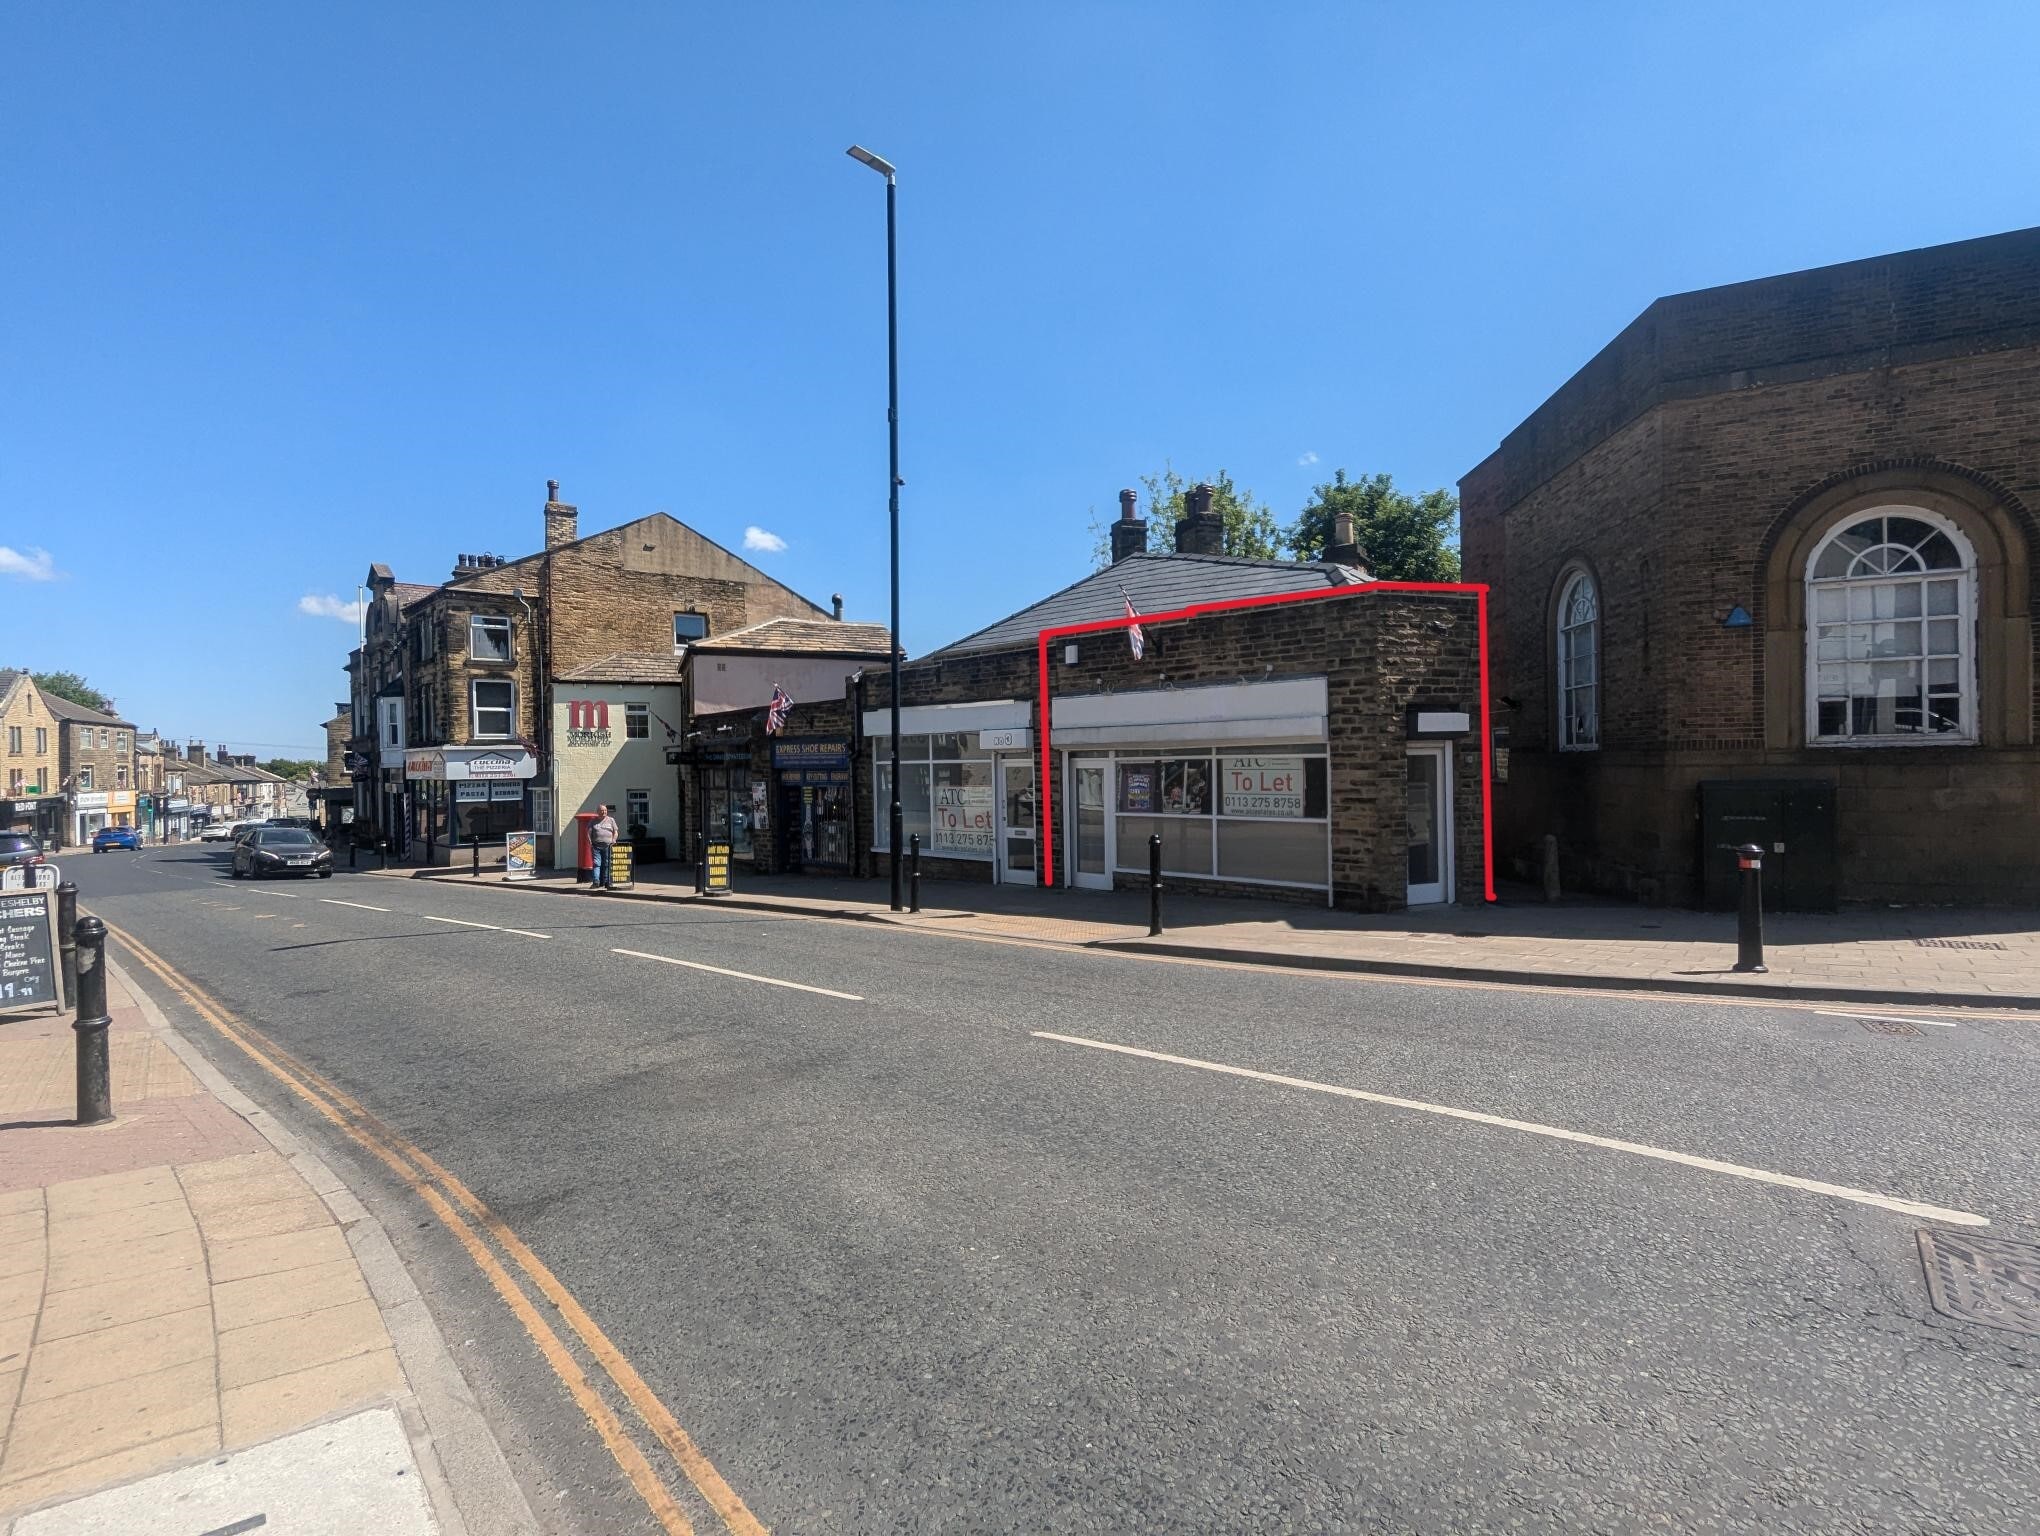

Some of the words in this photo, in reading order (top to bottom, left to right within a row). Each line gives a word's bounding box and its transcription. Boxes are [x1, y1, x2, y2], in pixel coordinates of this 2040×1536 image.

[776, 745, 800, 753] EXPRESS
[801, 744, 819, 753] SHOE
[820, 743, 846, 752] REPAIRS
[1231, 772, 1252, 791] To
[1260, 772, 1293, 792] Let
[940, 788, 965, 805] ATC
[1225, 796, 1249, 808] 0113
[1251, 797, 1270, 808] 275
[1273, 797, 1301, 809] 8758
[937, 808, 956, 828] To
[962, 808, 993, 829] Let
[956, 833, 974, 846] 275
[0, 906, 46, 920] HERS
